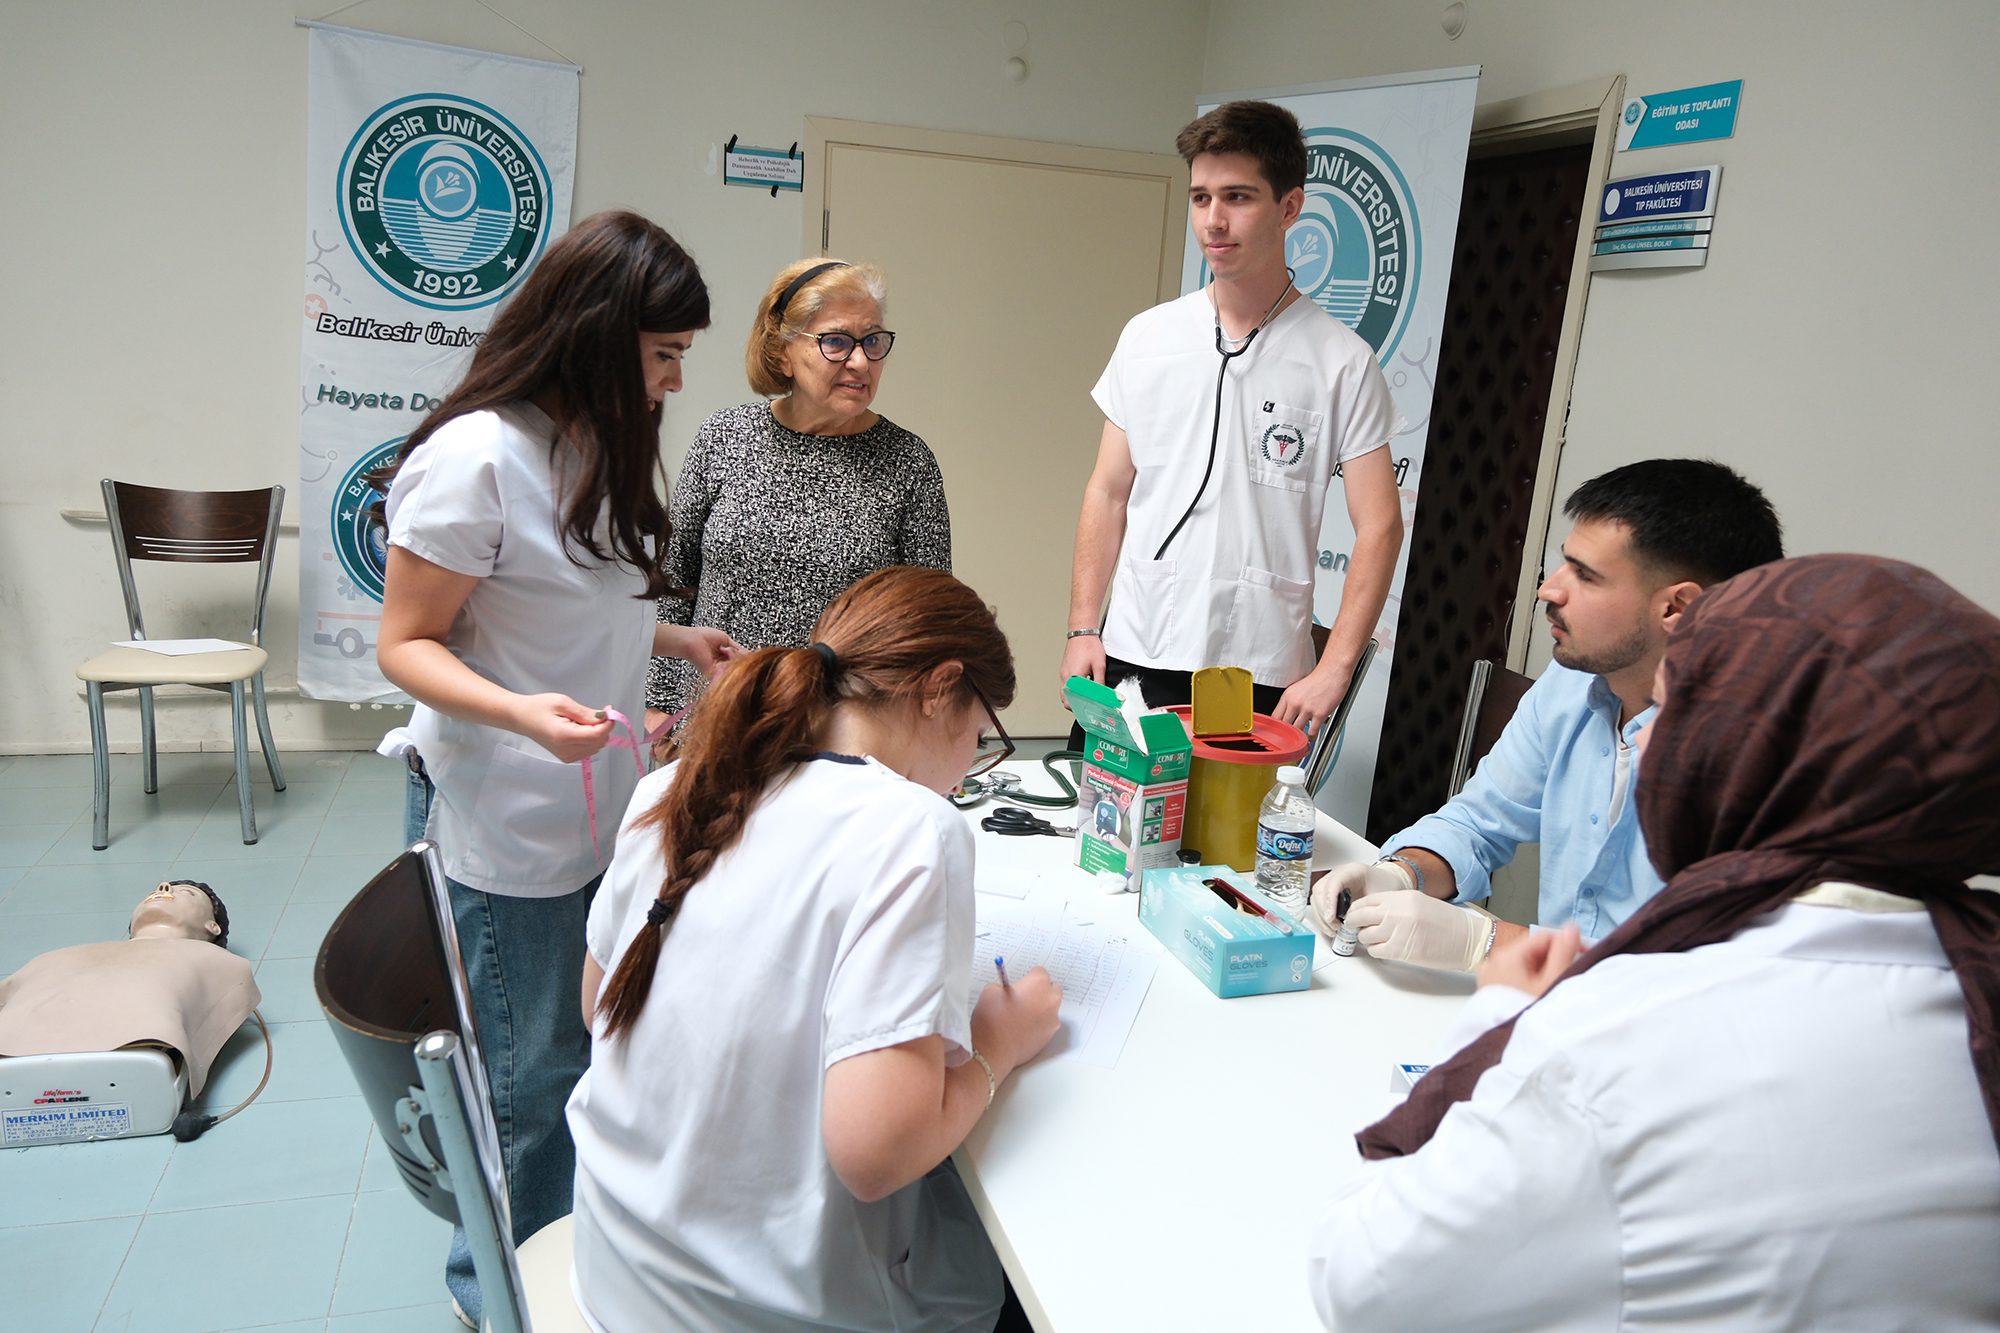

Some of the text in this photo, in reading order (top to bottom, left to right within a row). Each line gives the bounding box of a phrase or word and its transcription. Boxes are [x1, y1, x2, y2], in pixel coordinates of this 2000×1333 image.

[1651, 104, 1678, 118] EĞİTİM
[1680, 103, 1690, 114] VE
[1692, 97, 1732, 112] TOPLANTI
[1675, 118, 1699, 131] ODASI
[356, 109, 537, 232] BALIKESİR ÜNİVERSİTESİ
[1624, 176, 1703, 198] BALIKESİR ÜNİVERSİTESİ
[1635, 194, 1682, 211] TIP FAKÜLTESİ
[412, 269, 482, 296] 1992
[316, 312, 423, 343] Balıkesir
[317, 383, 405, 412] Hayata
[1183, 928, 1214, 962] GLOVES
[1229, 960, 1268, 971] GLOVES
[1230, 953, 1263, 963] PLATIN
[6, 1112, 66, 1124] MERKIM
[69, 1108, 126, 1120] LIMITED
